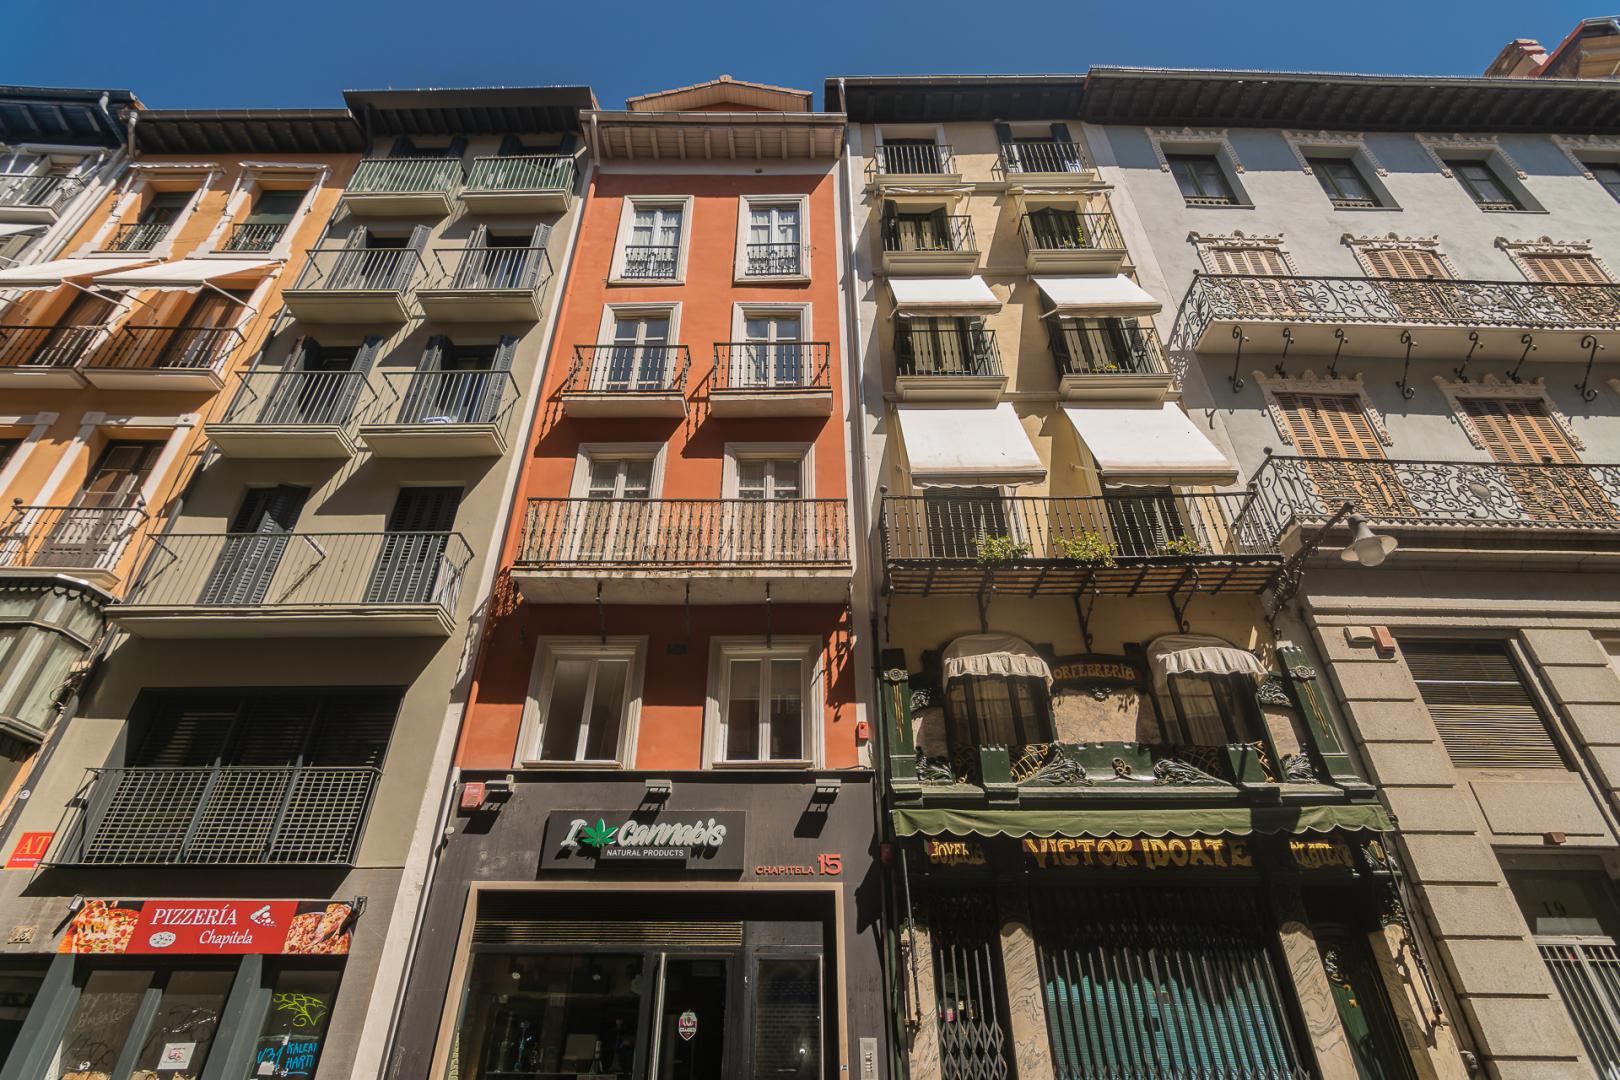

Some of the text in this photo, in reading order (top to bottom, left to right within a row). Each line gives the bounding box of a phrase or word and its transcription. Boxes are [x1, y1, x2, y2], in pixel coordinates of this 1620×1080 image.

[560, 818, 727, 847] I Cannabis
[15, 835, 52, 855] AT
[606, 849, 685, 857] NATURAL PRODUCTS
[1024, 838, 1253, 870] VICTOR IDOATE
[755, 853, 843, 876] CHAPITELA 15
[150, 904, 237, 925] PIZZERÍA
[199, 928, 253, 949] Chapitela
